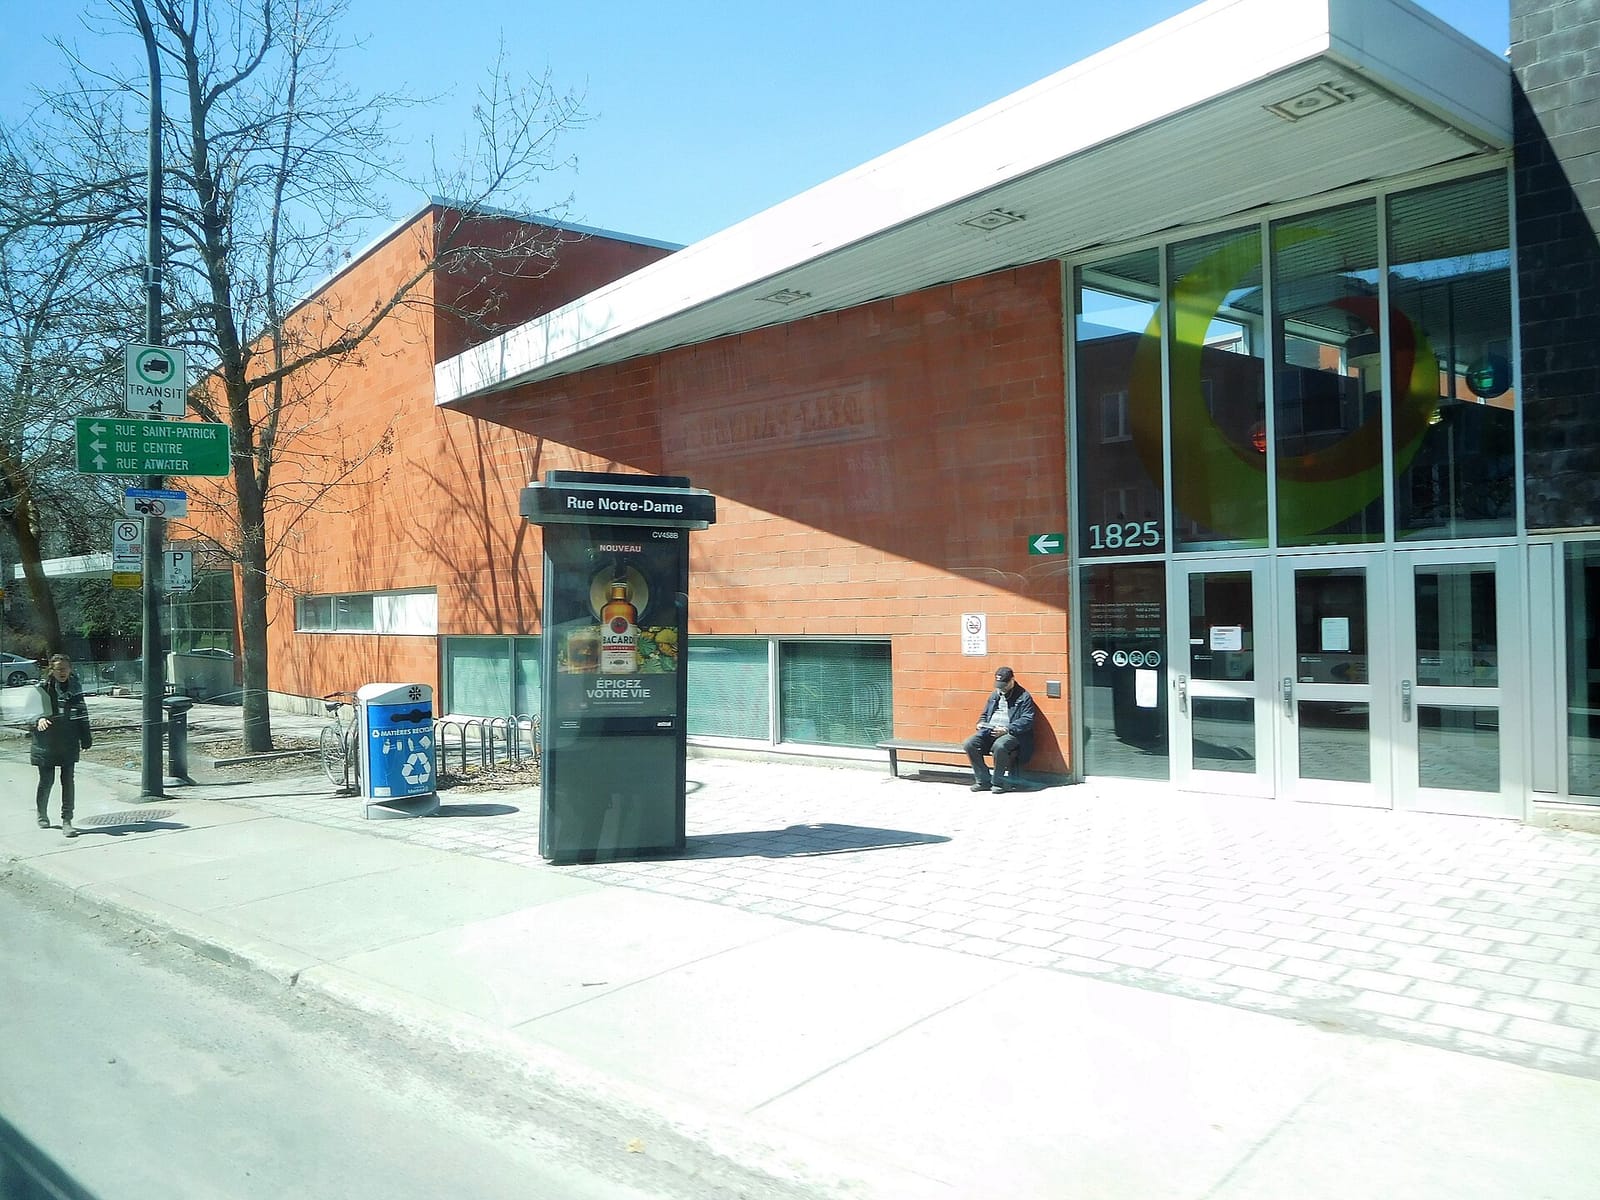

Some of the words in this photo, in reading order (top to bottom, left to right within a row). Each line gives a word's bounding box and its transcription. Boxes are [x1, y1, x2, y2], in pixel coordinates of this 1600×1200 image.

[128, 384, 183, 399] TRANSIT
[115, 424, 136, 436] RUE
[142, 426, 216, 439] SAINT-PATRICK
[115, 441, 137, 453] RUE
[143, 442, 183, 454] CENTRE
[116, 458, 138, 469] RUE
[144, 459, 189, 471] ATWATER
[567, 496, 594, 510] Rue
[598, 497, 684, 514] Notre-Dame
[1089, 521, 1160, 550] 1825
[599, 544, 642, 553] NOUVEAU
[172, 552, 184, 567] P
[596, 677, 642, 689] ÉPICEZ
[586, 689, 628, 698] VOTRE
[630, 689, 651, 698] VIE
